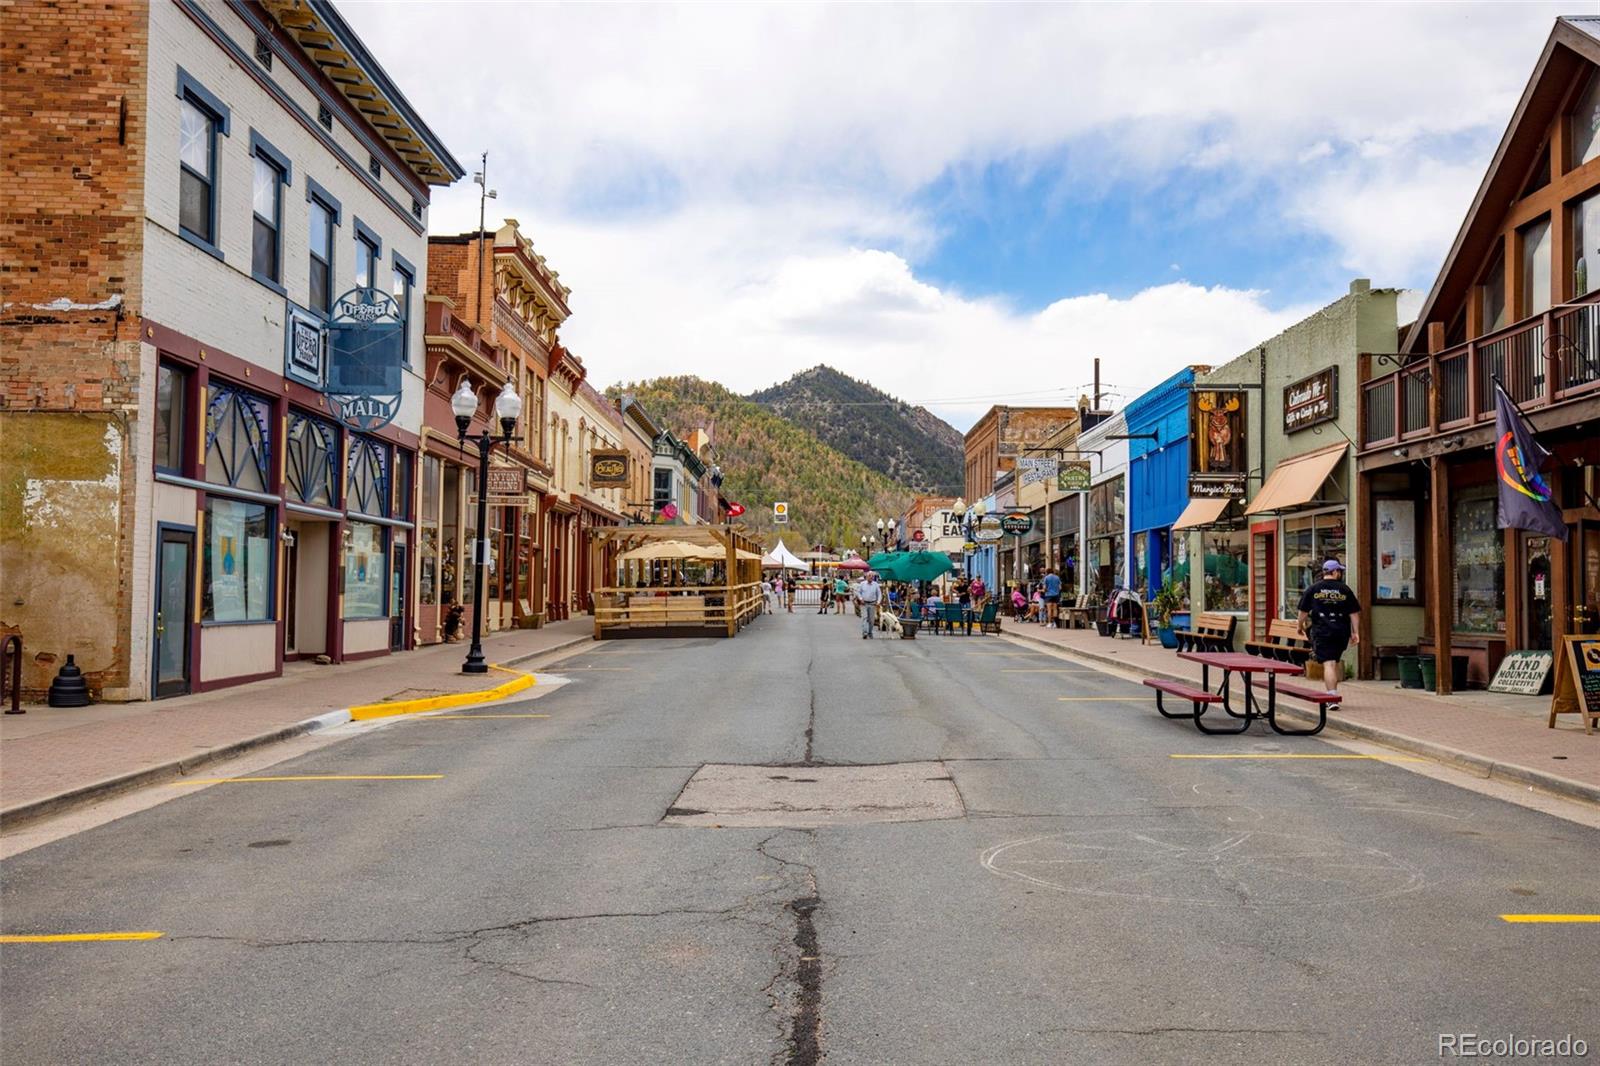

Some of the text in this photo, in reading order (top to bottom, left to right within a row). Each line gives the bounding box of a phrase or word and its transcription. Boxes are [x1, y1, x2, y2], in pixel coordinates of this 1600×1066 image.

[343, 400, 390, 420] MALL
[1192, 483, 1245, 496] Margie's Place
[1508, 660, 1540, 671] KIND
[1498, 670, 1544, 680] MOUNTAIN
[1497, 679, 1536, 687] COLLECTIVE
